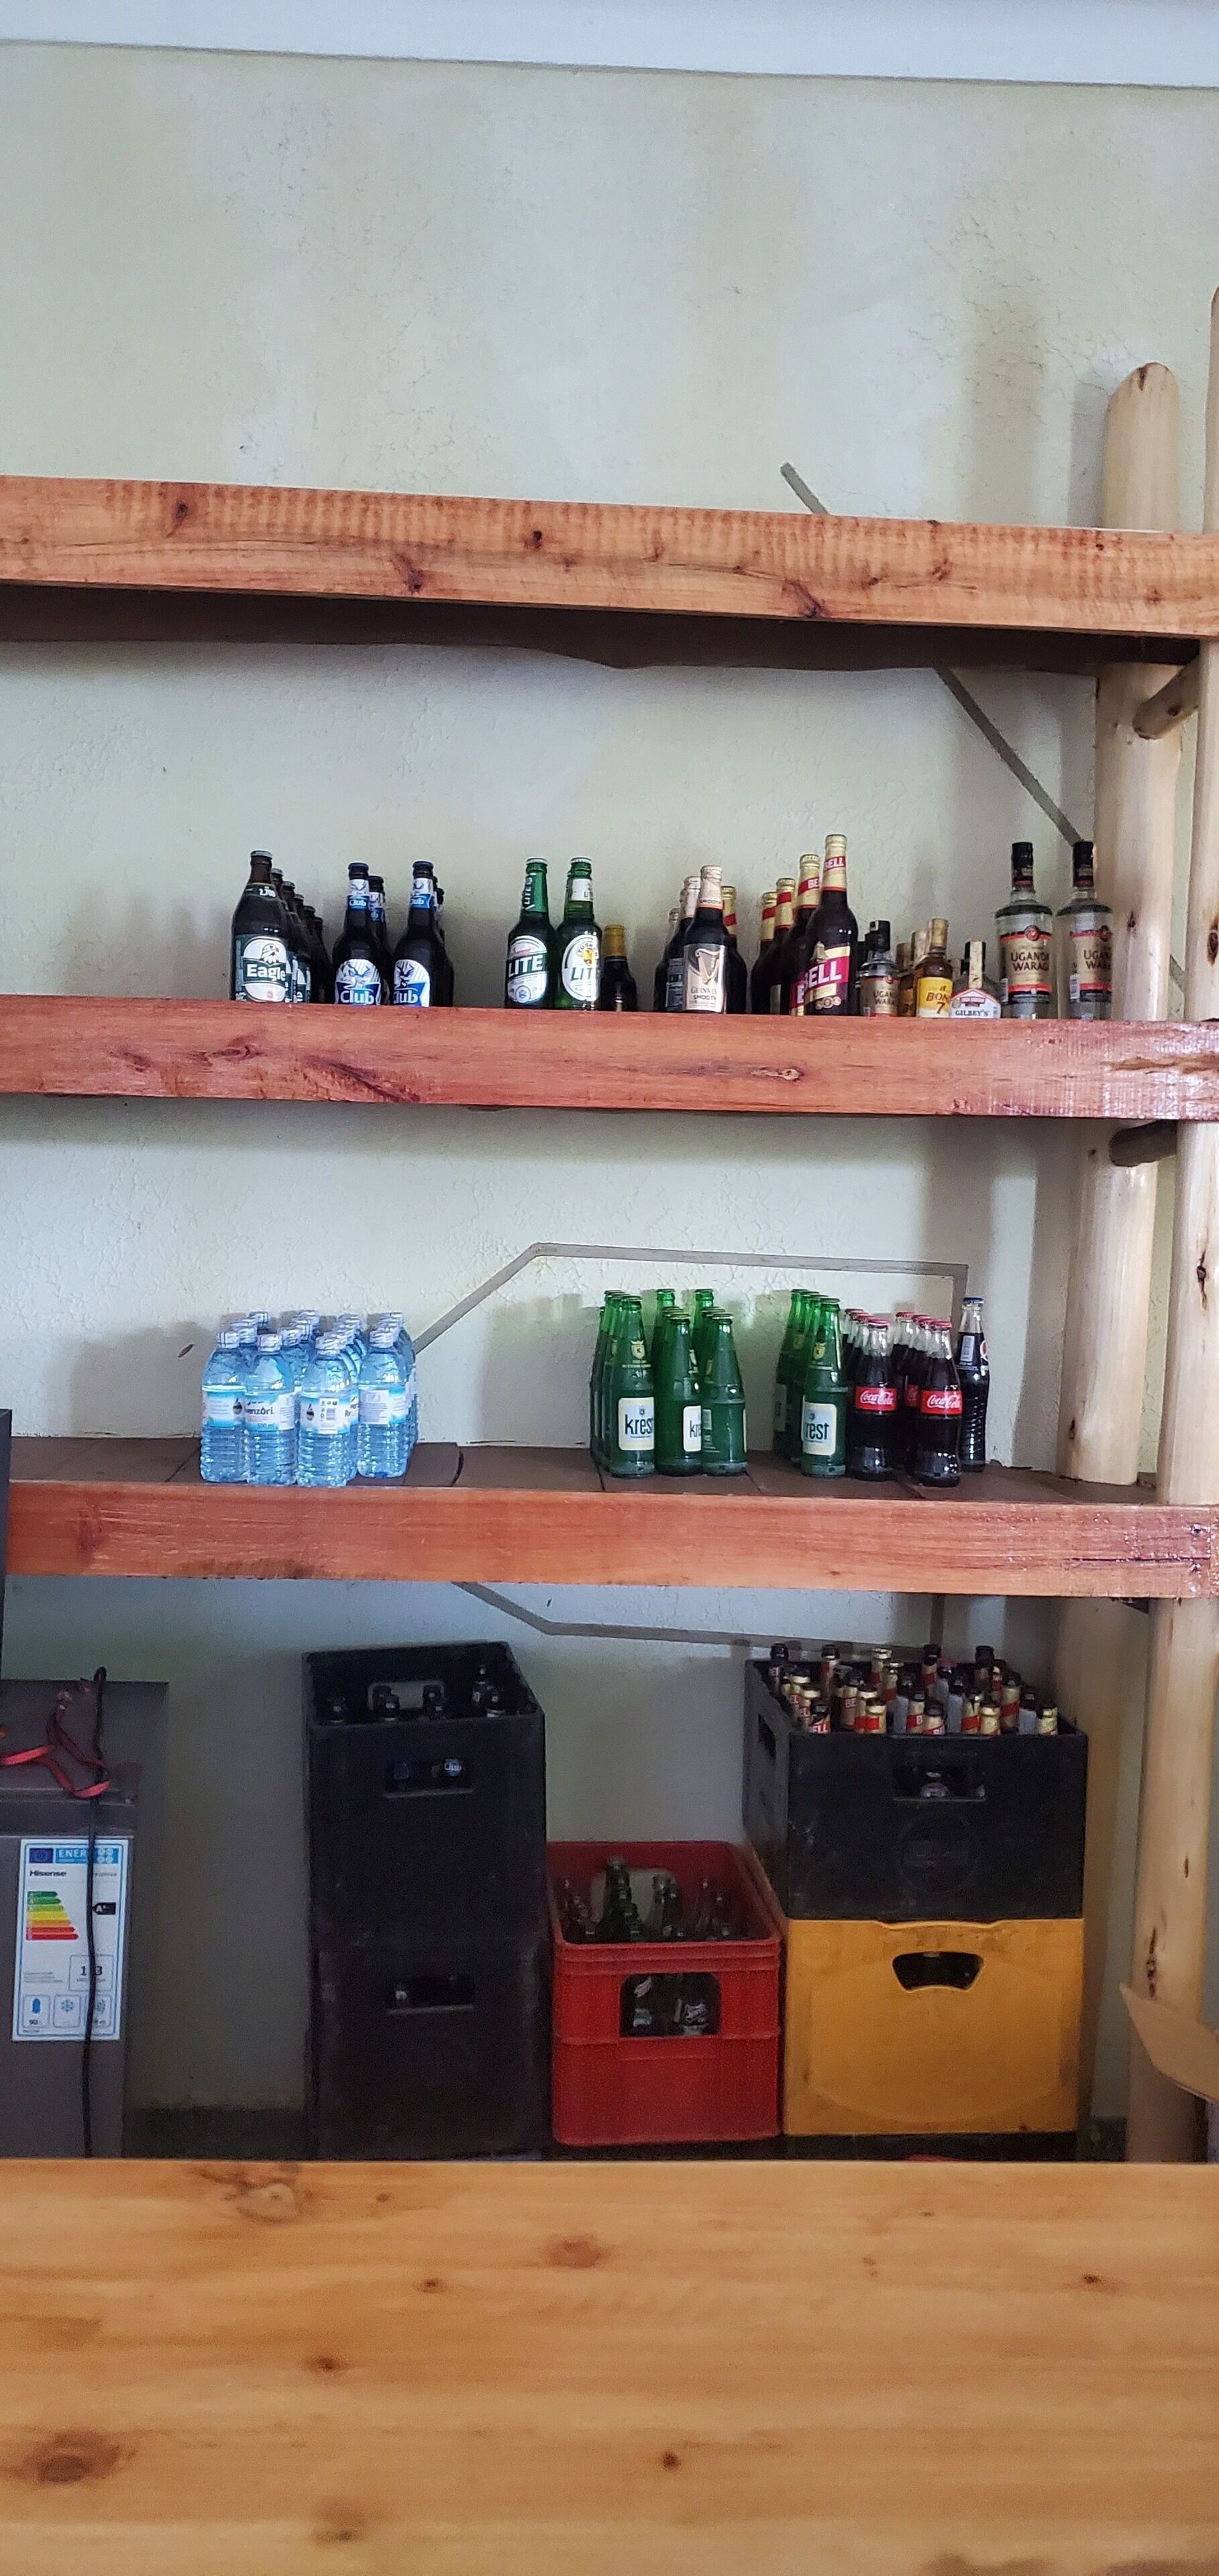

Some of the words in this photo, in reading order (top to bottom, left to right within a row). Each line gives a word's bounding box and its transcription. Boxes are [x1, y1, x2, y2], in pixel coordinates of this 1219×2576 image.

[1011, 952, 1049, 961] UGAND
[246, 963, 286, 981] Eagle
[509, 955, 543, 977] LITE
[1012, 961, 1049, 971] WARAG
[570, 967, 593, 981] LIT
[340, 990, 374, 1005] Club
[926, 992, 948, 1002] BON
[937, 1002, 945, 1014] 7
[805, 1421, 829, 1440] rest
[58, 1849, 87, 1859] ENER
[81, 1966, 103, 1976] 13
